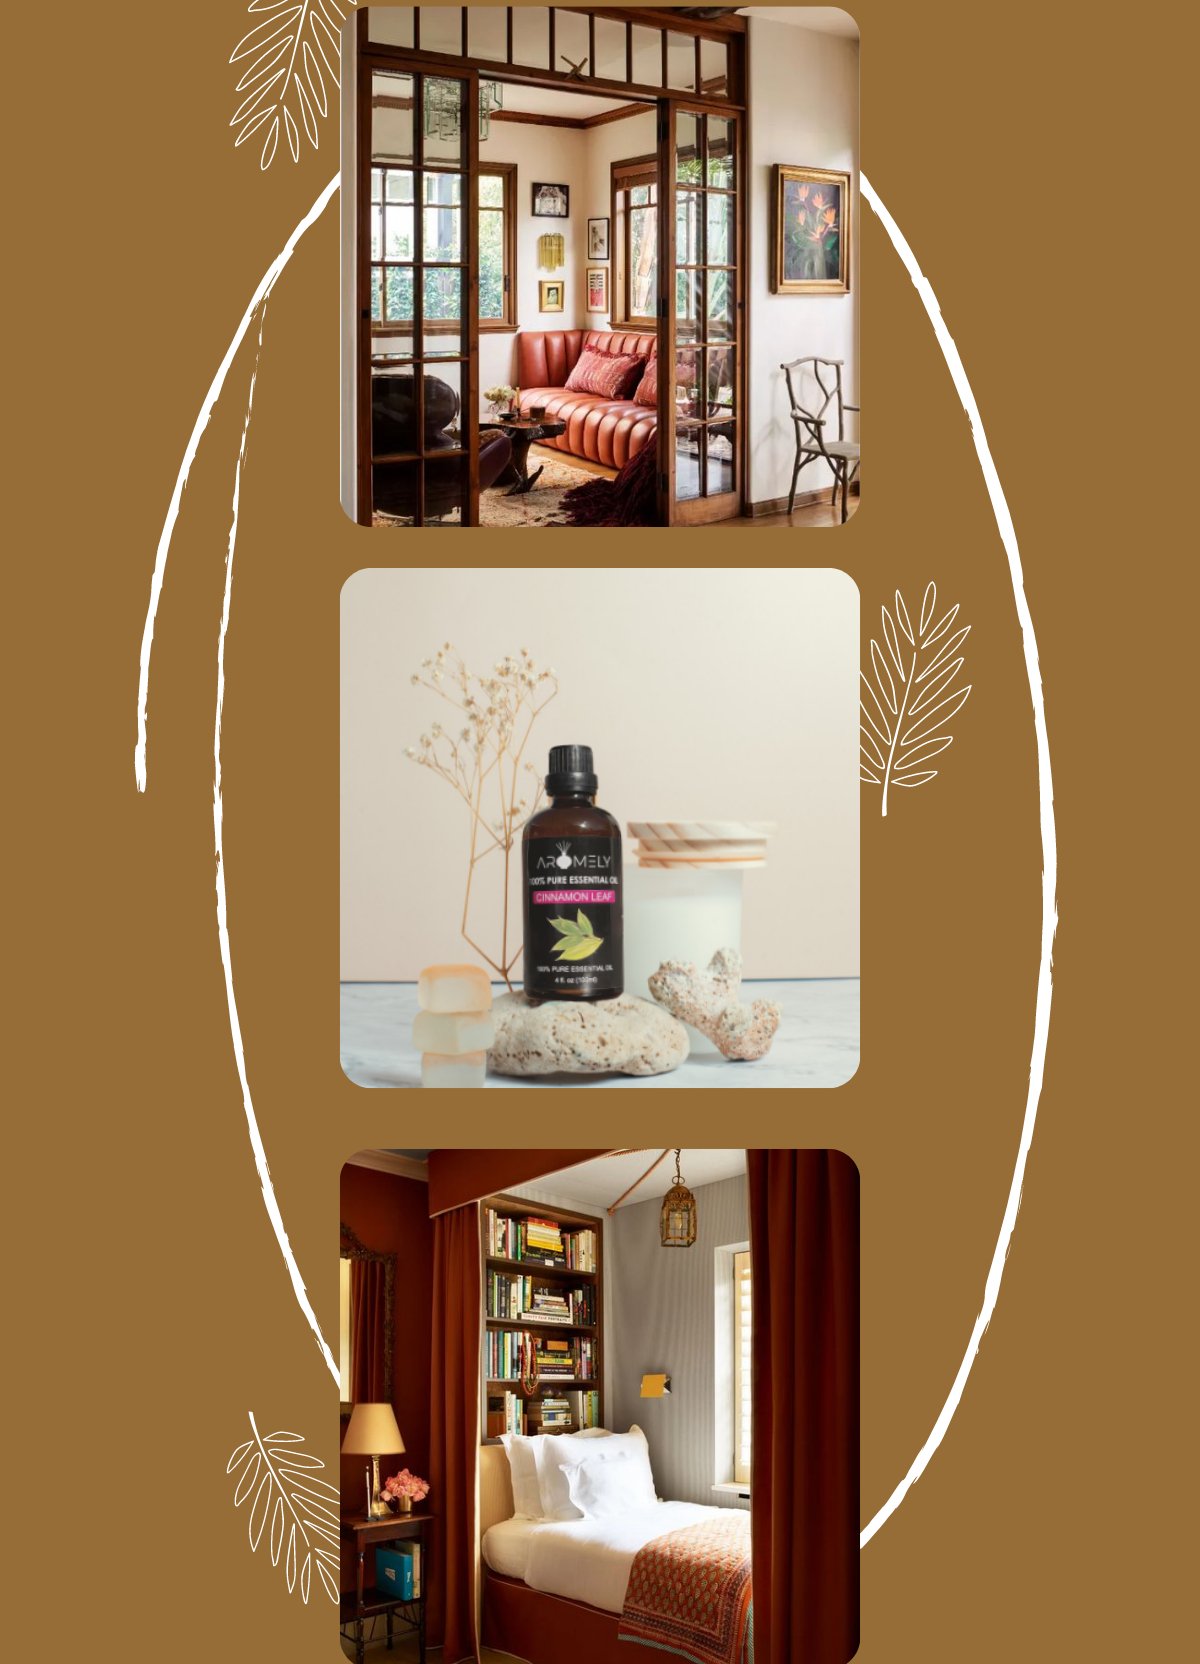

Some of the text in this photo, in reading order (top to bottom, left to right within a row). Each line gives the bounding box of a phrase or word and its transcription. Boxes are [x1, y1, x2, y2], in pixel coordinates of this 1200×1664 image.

[546, 876, 567, 885] PURE
[569, 876, 608, 885] ESSENTIAL
[536, 891, 612, 902] CINNAMON LEAF
[551, 965, 569, 973] PURE
[570, 965, 604, 973] ESSENTIAL
